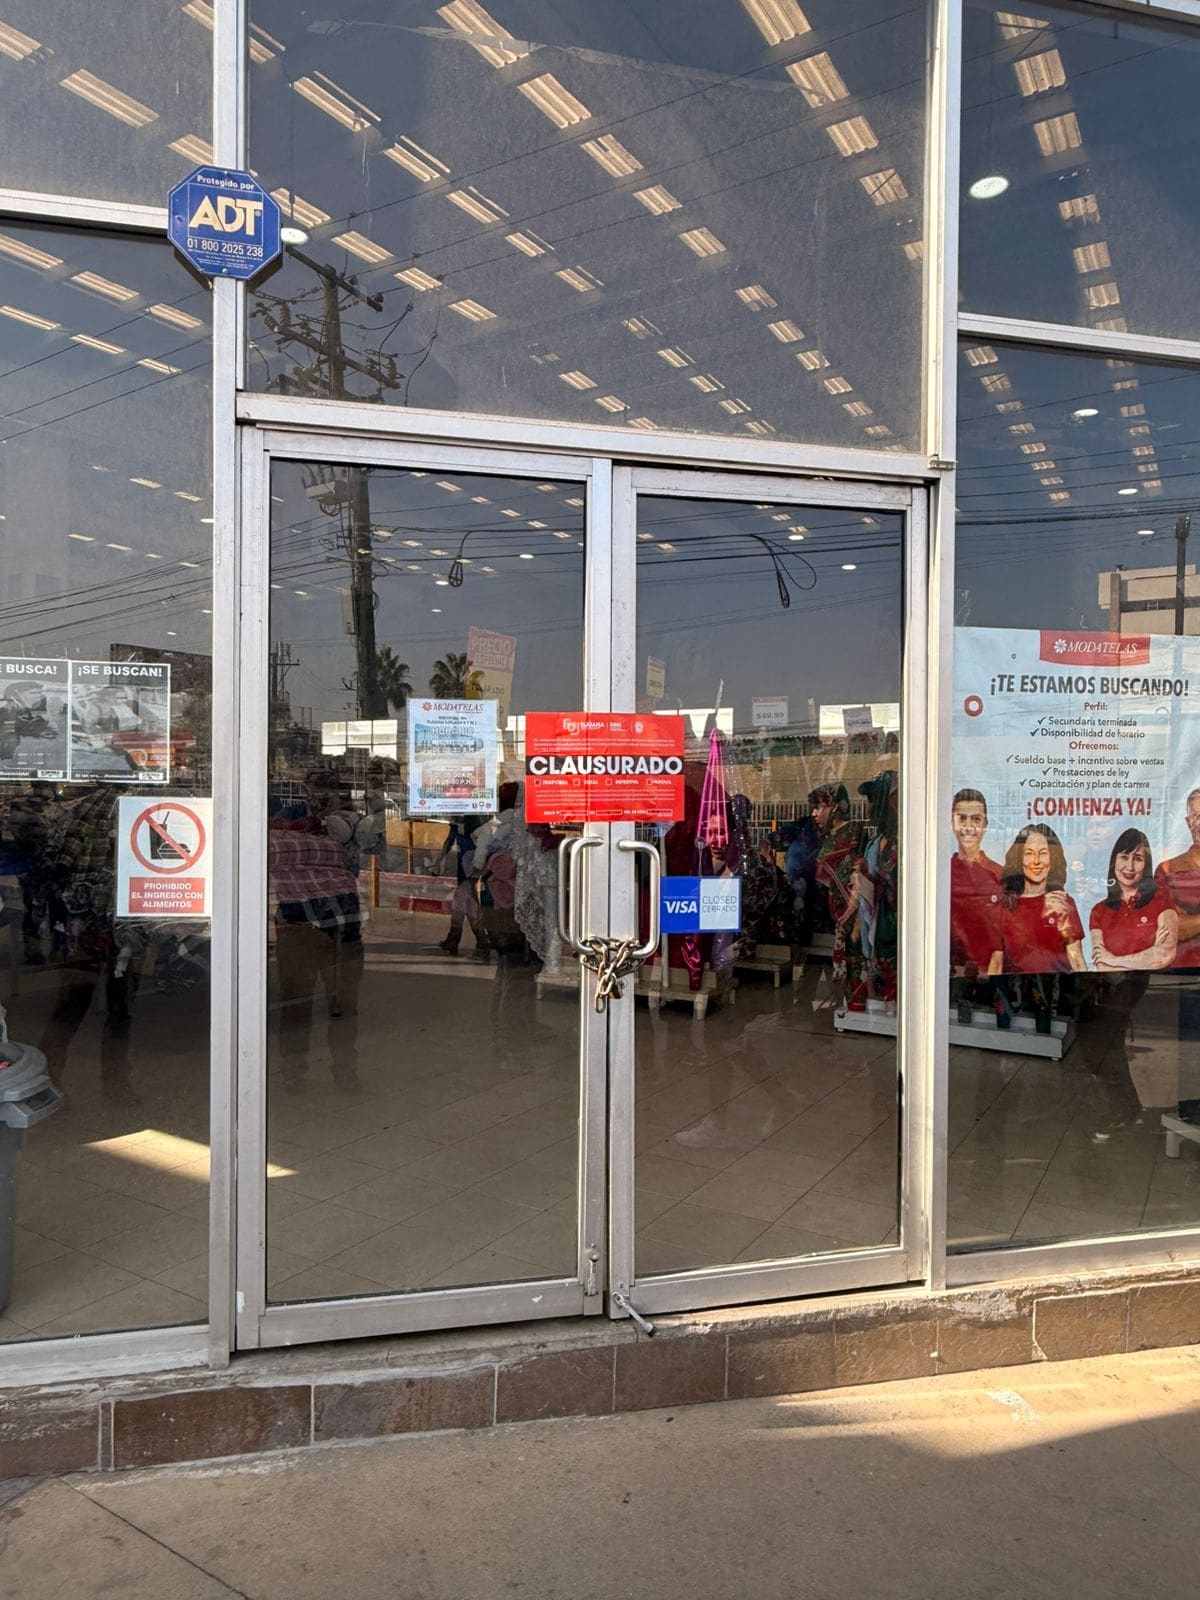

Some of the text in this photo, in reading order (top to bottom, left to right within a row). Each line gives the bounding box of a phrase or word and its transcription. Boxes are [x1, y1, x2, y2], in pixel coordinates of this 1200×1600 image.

[197, 175, 255, 190] Protegido por
[188, 195, 263, 236] ADT
[187, 238, 198, 249] 01
[201, 240, 219, 252] 800
[221, 242, 244, 255] 2025
[246, 246, 264, 257] 238
[472, 636, 512, 656] PRECIO
[1067, 641, 1137, 654] MODATELAS
[6, 663, 57, 675] BUSCA!
[78, 665, 162, 677] ¡SE BUSCAN!
[990, 674, 1189, 696] ¡TE ESTAMOS BUSCANDO!
[432, 703, 485, 711] MODATELAS
[1084, 702, 1108, 711] Perfil:
[1048, 717, 1137, 726] Secundaria terminada
[1041, 728, 1145, 739] Disponibilidad de horario
[1069, 741, 1119, 750] Ofrecemos:
[529, 756, 683, 775] CLAUSURADO
[1014, 756, 1045, 764] Sueldo
[1047, 756, 1066, 764] base
[1078, 756, 1114, 765] incentivo
[1116, 756, 1138, 765] sobre
[1053, 767, 1130, 779] Prestaciones de ley
[1029, 778, 1085, 789] Capacitación
[1086, 781, 1092, 790] y
[1092, 779, 1111, 789] plan
[1113, 780, 1122, 788] de
[1026, 797, 1153, 819] ¡COMIENZA YA!
[143, 882, 192, 890] PROHIBIDO
[131, 891, 204, 899] EL INGRESO CON
[702, 896, 737, 905] CLOSED
[143, 900, 192, 908] ALIMENTOS
[663, 901, 698, 914] VISA
[702, 905, 737, 913] CERRADO
